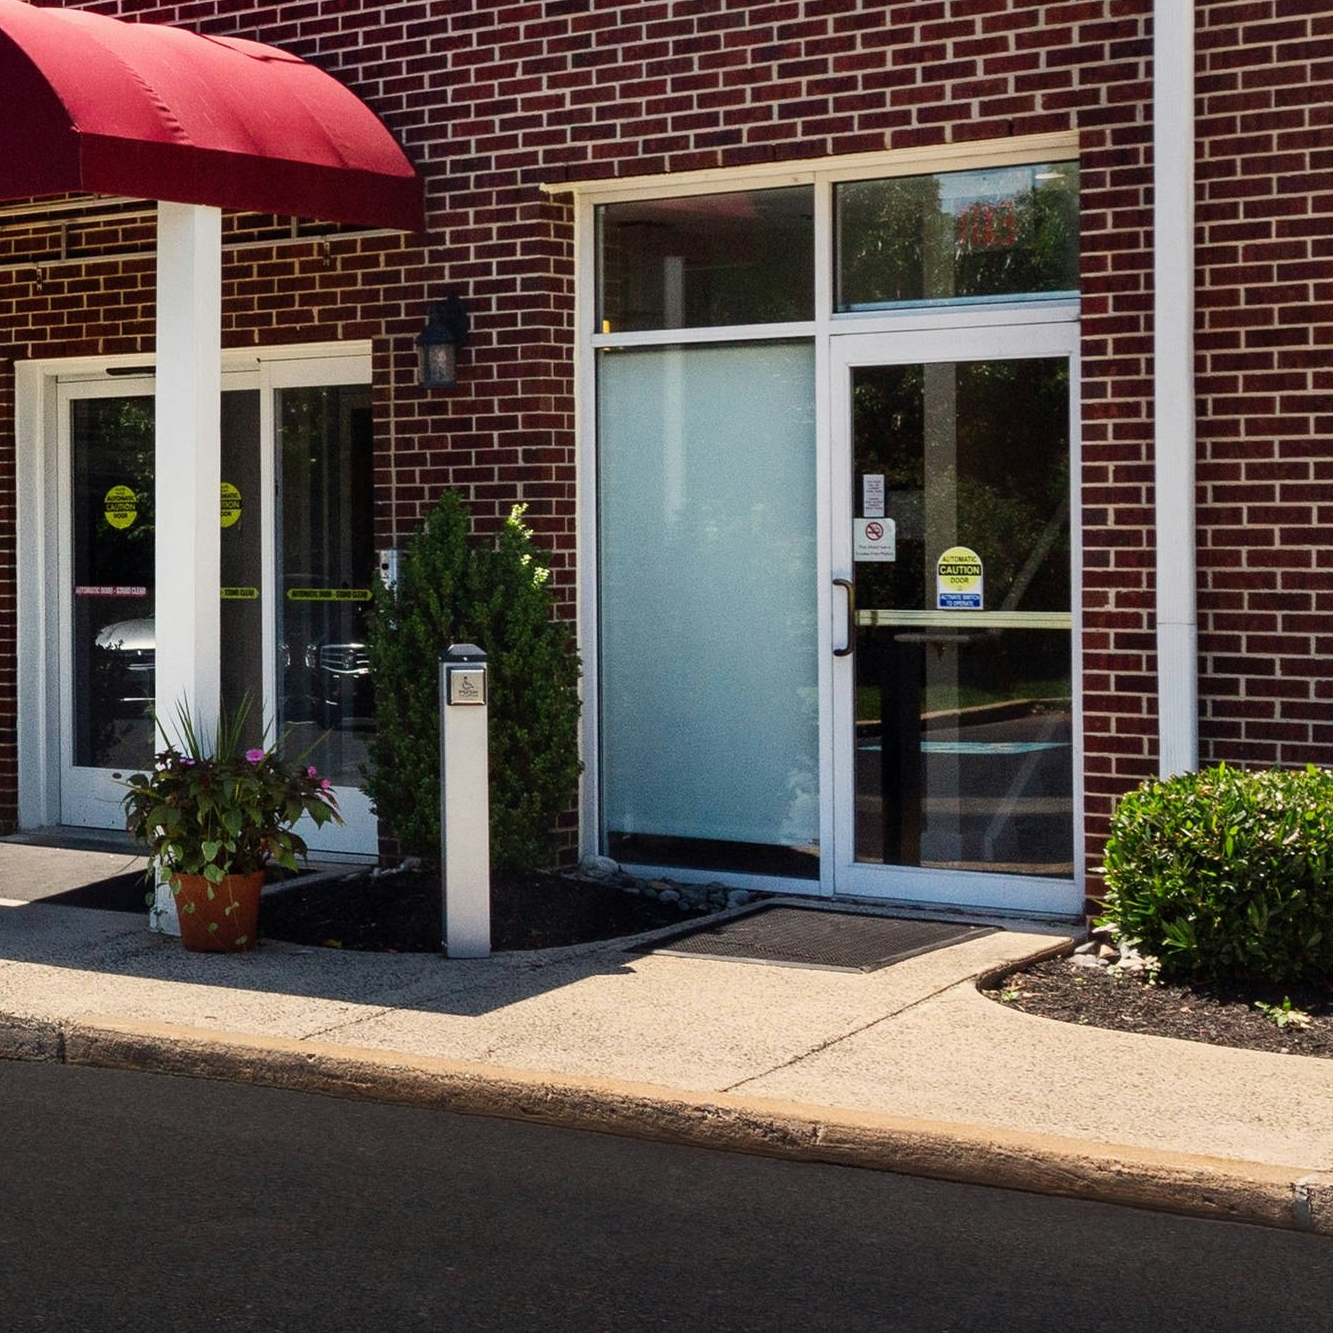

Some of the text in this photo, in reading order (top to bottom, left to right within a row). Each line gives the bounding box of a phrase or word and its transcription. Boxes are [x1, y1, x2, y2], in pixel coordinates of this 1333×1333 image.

[106, 503, 136, 511] CAUTION
[942, 555, 978, 563] AUTOMATIC
[939, 565, 980, 575] CAUTION
